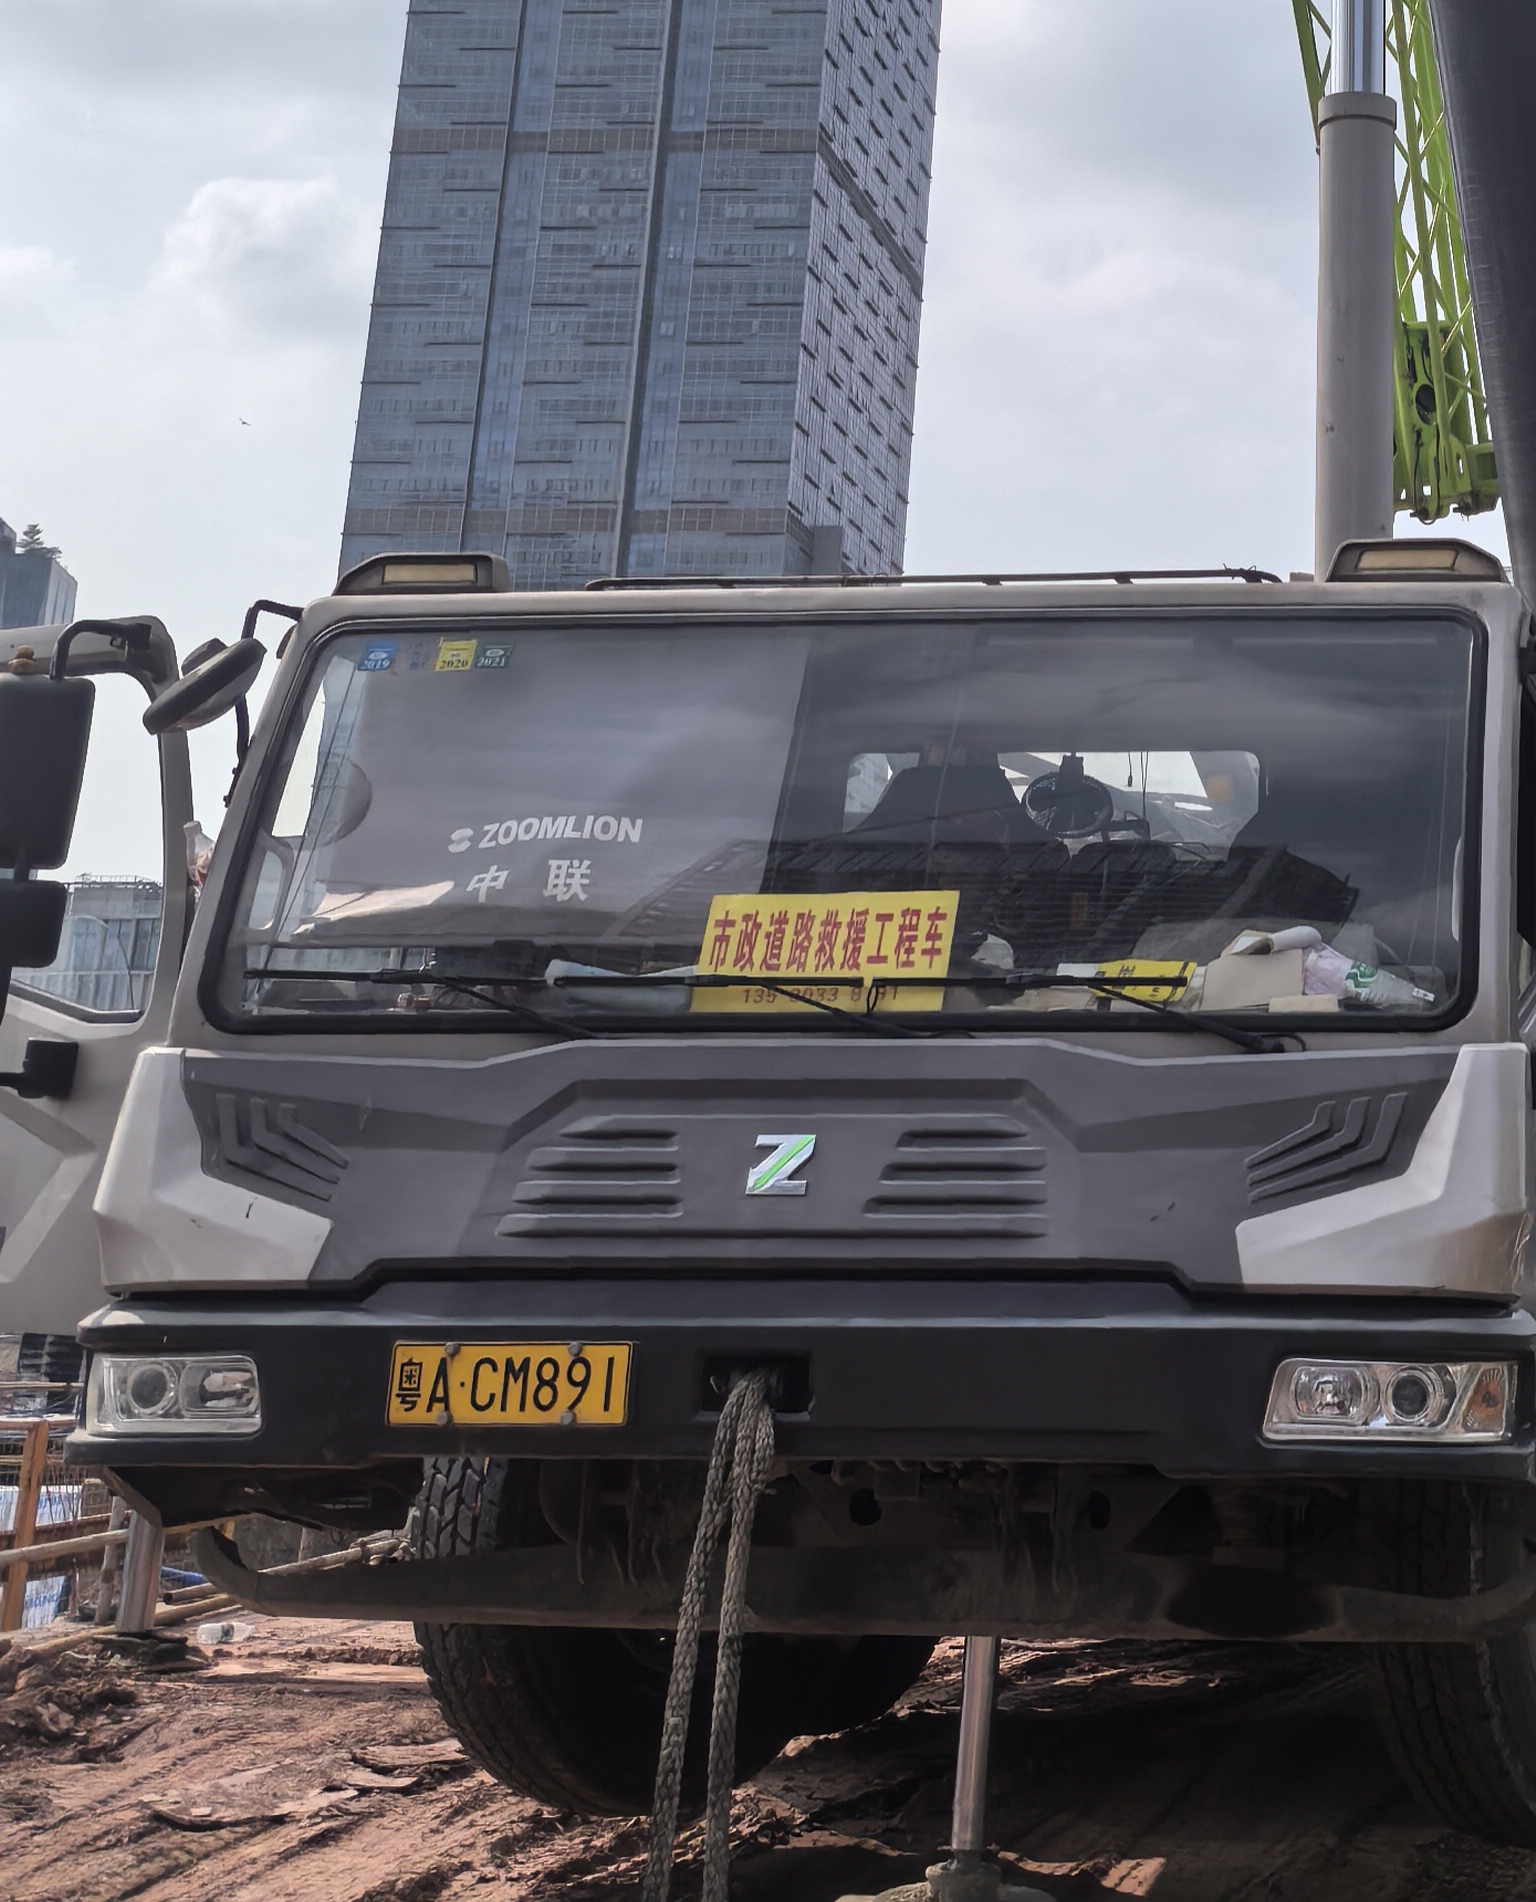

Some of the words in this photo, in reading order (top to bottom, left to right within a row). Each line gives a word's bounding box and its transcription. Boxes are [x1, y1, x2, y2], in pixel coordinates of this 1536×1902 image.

[361, 658, 391, 670] 2019
[440, 659, 469, 669] 2020
[477, 656, 506, 667] 2021
[478, 815, 644, 849] ZOOMLION
[708, 906, 948, 973] 市政道路救援工程车
